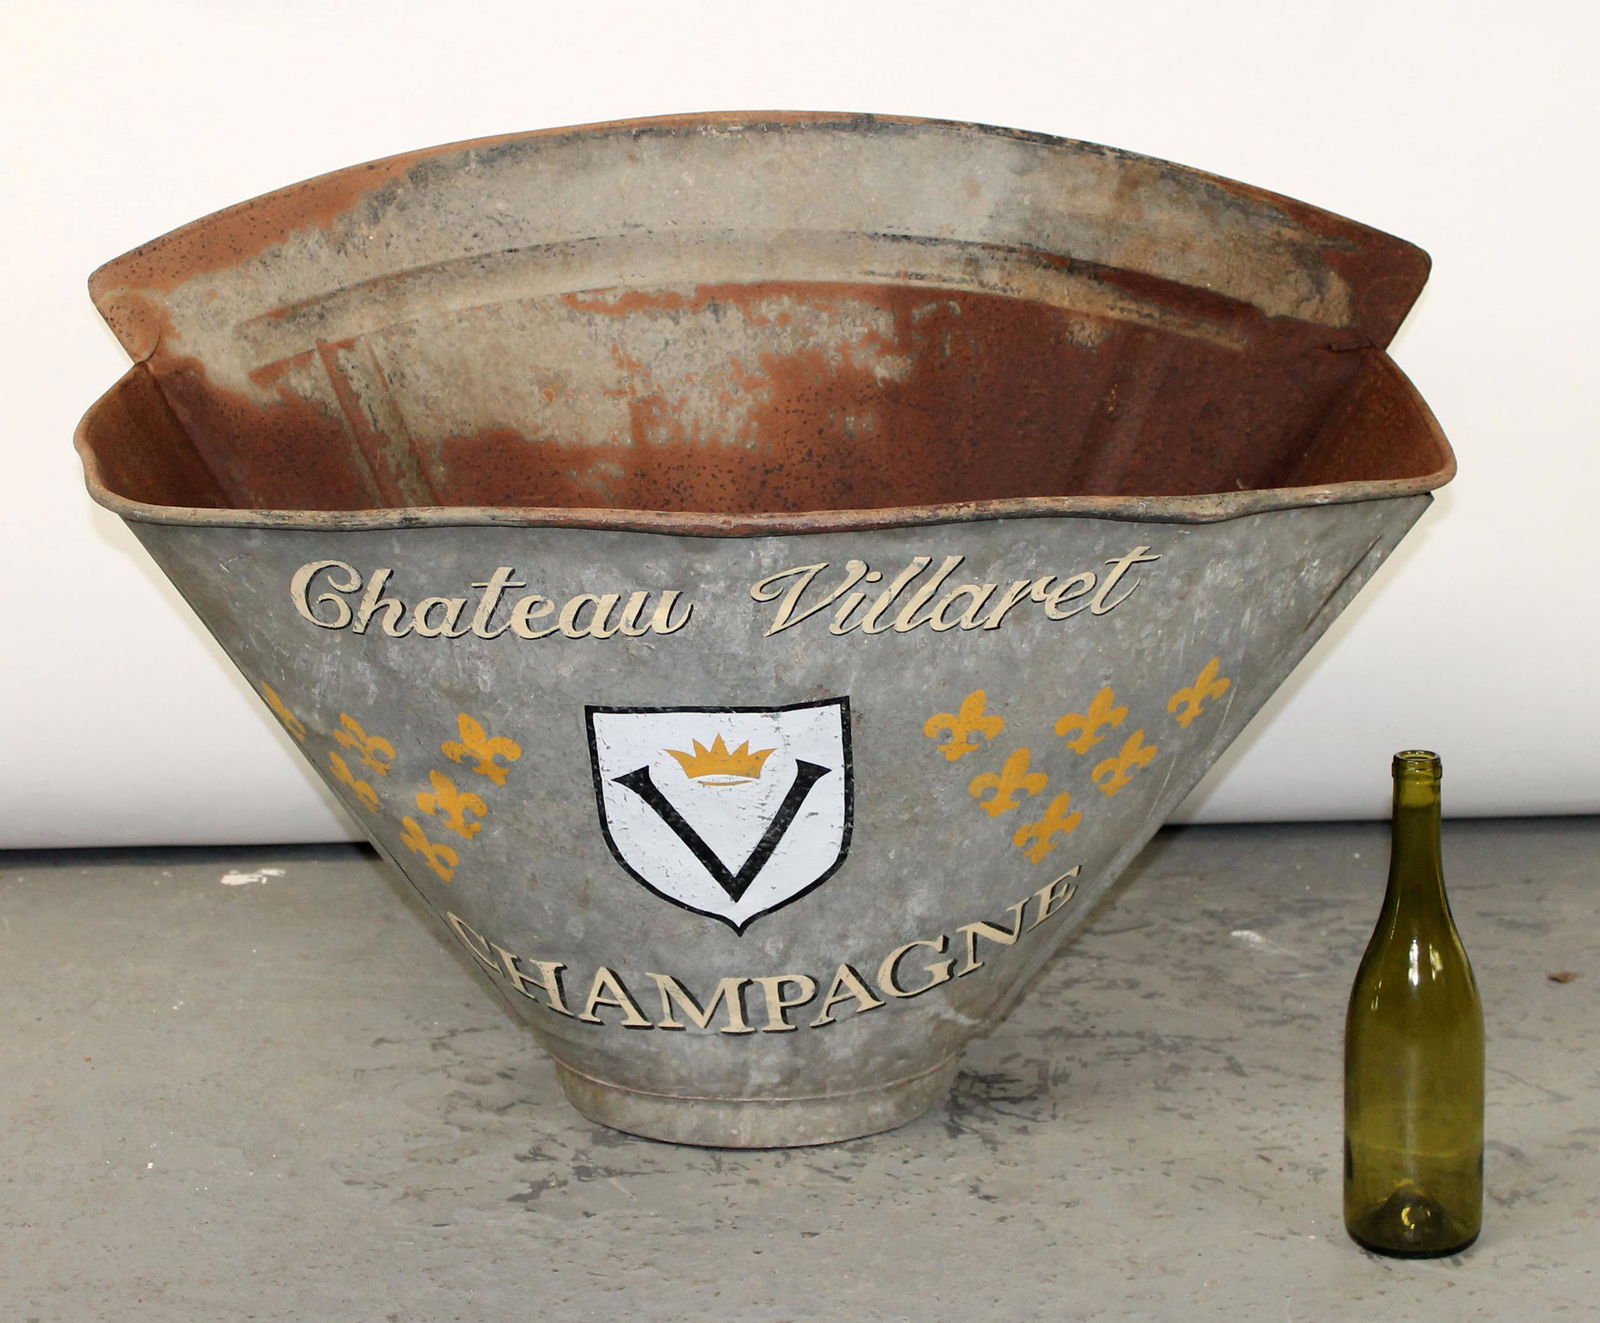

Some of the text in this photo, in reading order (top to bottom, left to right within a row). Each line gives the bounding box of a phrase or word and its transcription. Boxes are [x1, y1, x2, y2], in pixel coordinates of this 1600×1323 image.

[290, 545, 1163, 640] Chateau Villaret
[611, 758, 832, 903] V
[447, 864, 1082, 1034] CHAMPAGNE
